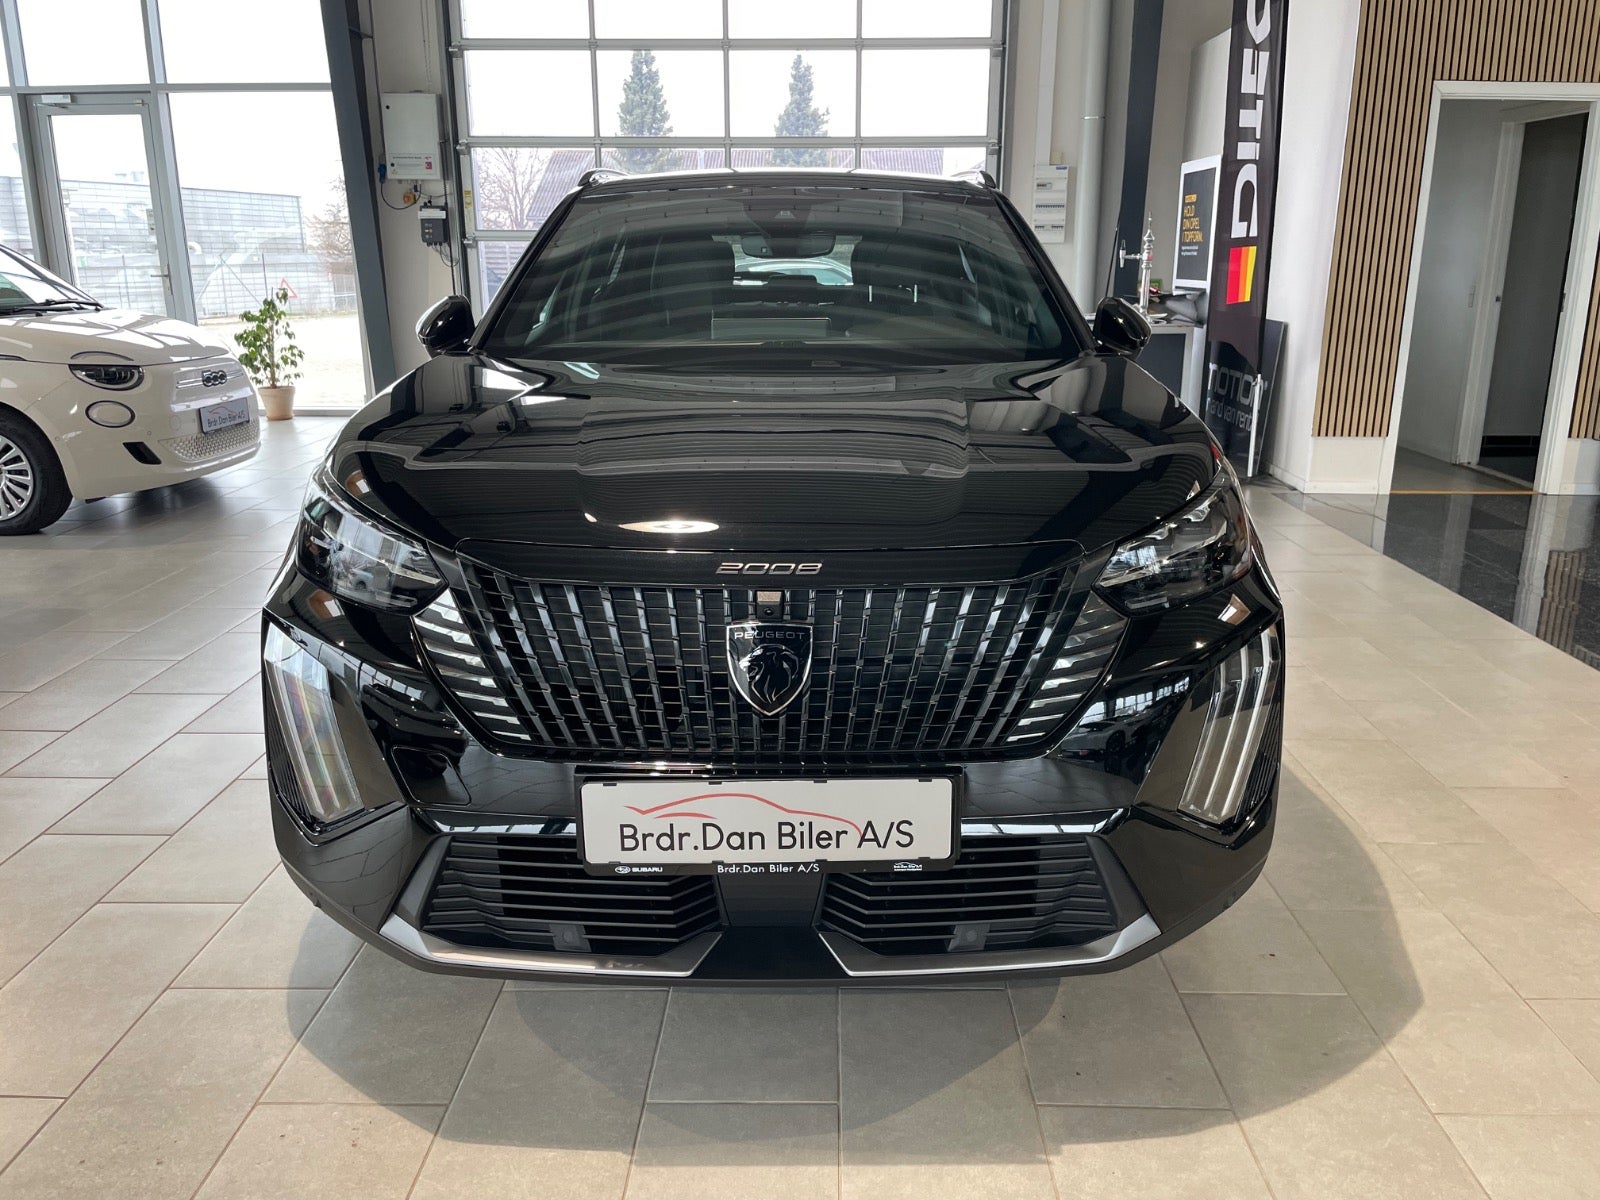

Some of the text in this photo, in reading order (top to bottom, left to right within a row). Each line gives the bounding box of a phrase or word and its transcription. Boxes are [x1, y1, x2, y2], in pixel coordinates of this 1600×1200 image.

[202, 370, 227, 387] 500
[716, 562, 822, 575] 2008
[734, 631, 806, 640] PEUGEOT
[777, 821, 848, 850] Biler
[857, 820, 914, 849] A/S
[769, 864, 793, 873] Biler
[797, 863, 820, 873] A/S
